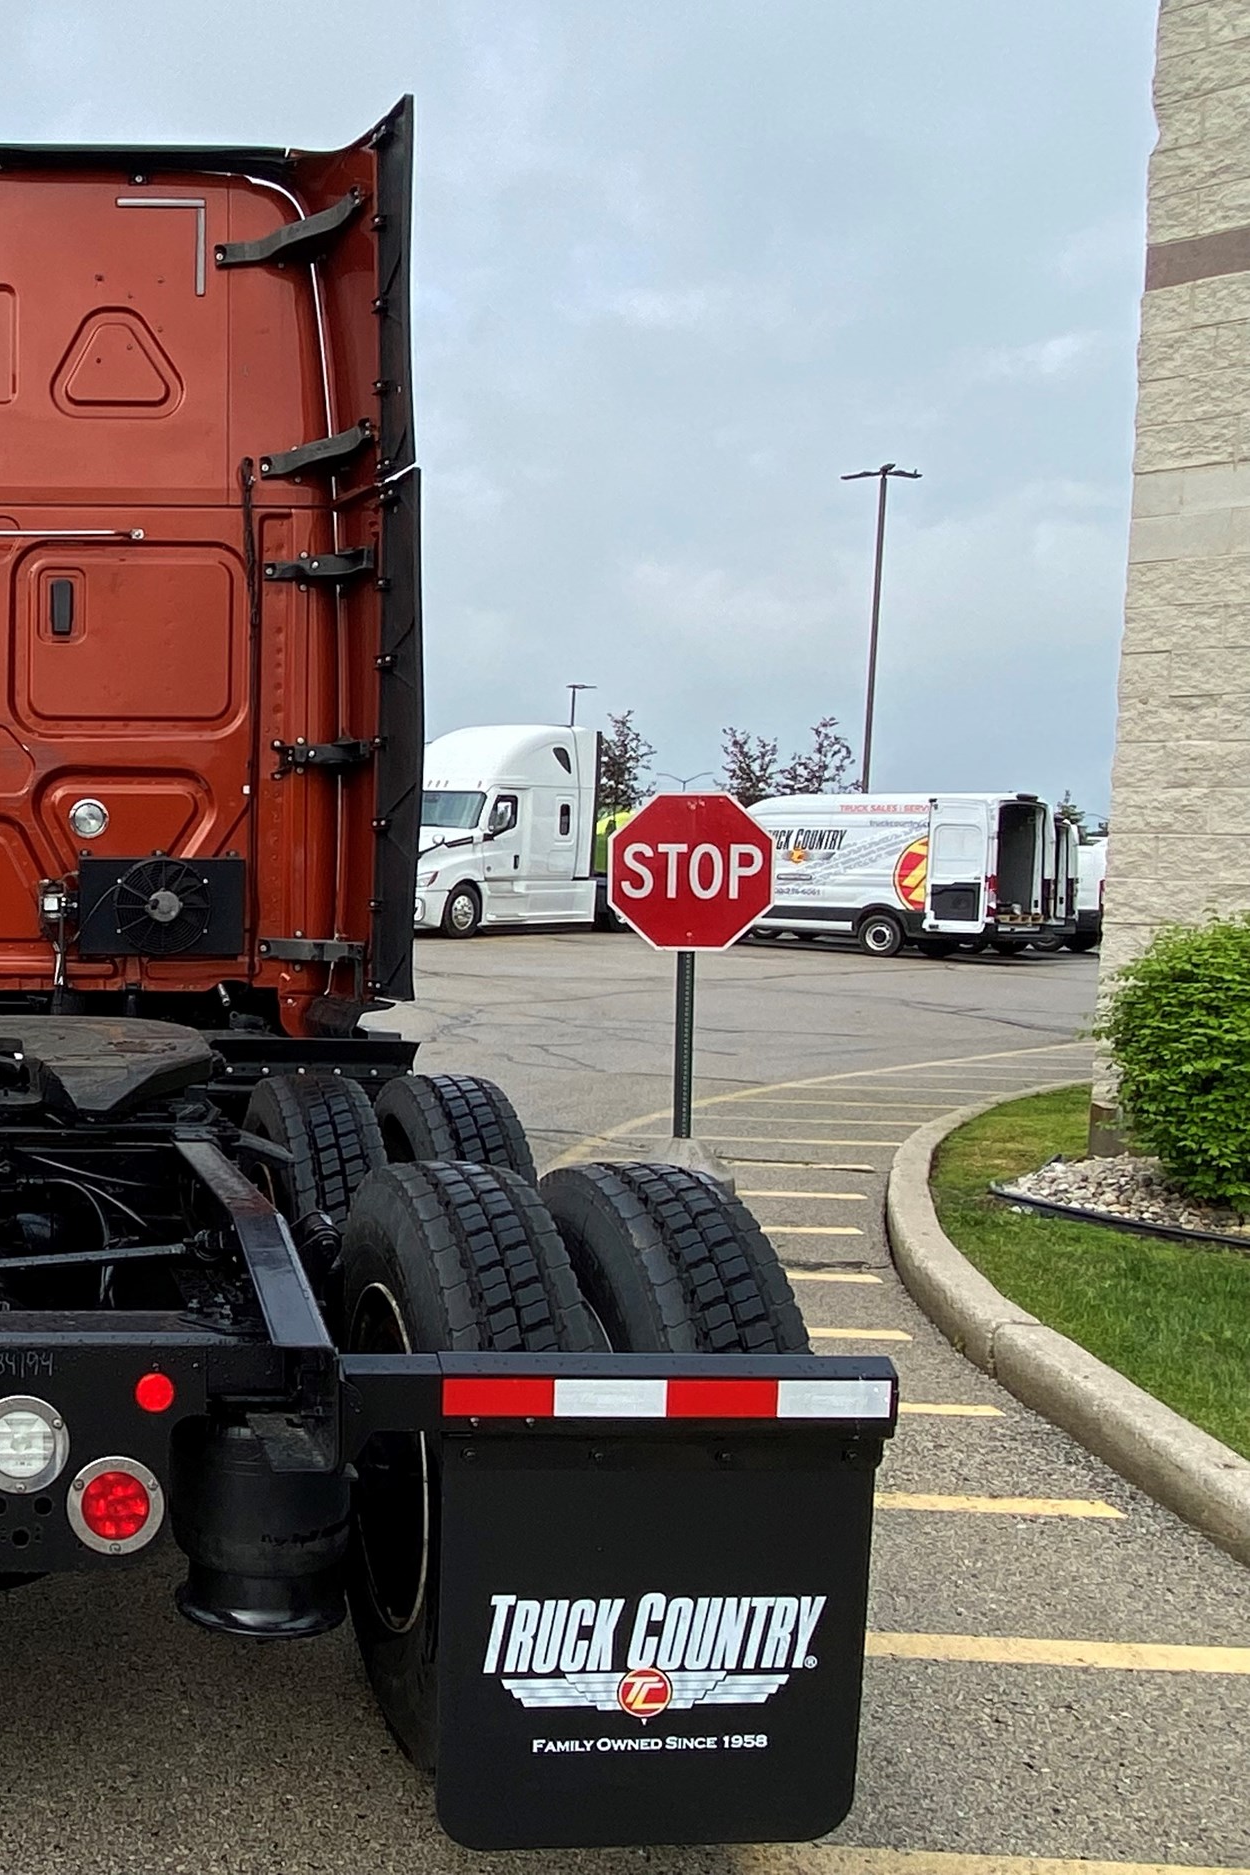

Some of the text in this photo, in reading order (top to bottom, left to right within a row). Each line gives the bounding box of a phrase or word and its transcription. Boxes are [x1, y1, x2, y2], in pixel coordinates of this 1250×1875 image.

[840, 804, 930, 813] TRUCK SALES SERV
[793, 828, 847, 851] COUNTRY
[620, 842, 764, 900] STOP
[483, 1594, 626, 1675] TRUCK
[532, 1734, 769, 1753] FAMILY OWNED SINCE 1958
